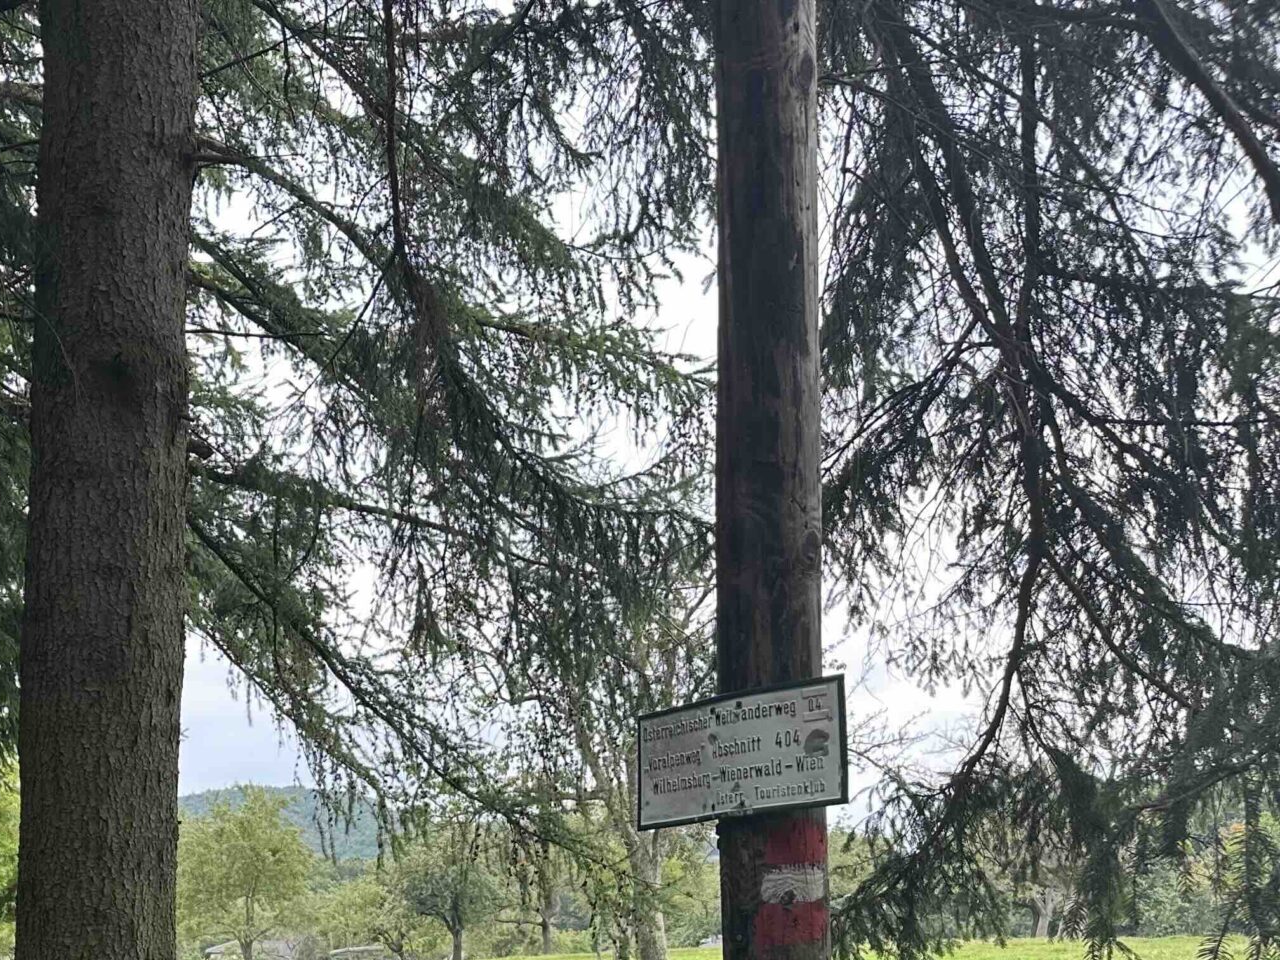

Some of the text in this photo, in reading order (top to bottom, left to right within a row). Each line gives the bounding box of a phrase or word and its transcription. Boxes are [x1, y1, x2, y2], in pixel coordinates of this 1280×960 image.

[712, 737, 761, 759] Abschnitt
[775, 729, 800, 748] 404
[754, 780, 825, 800] Touristenklub
